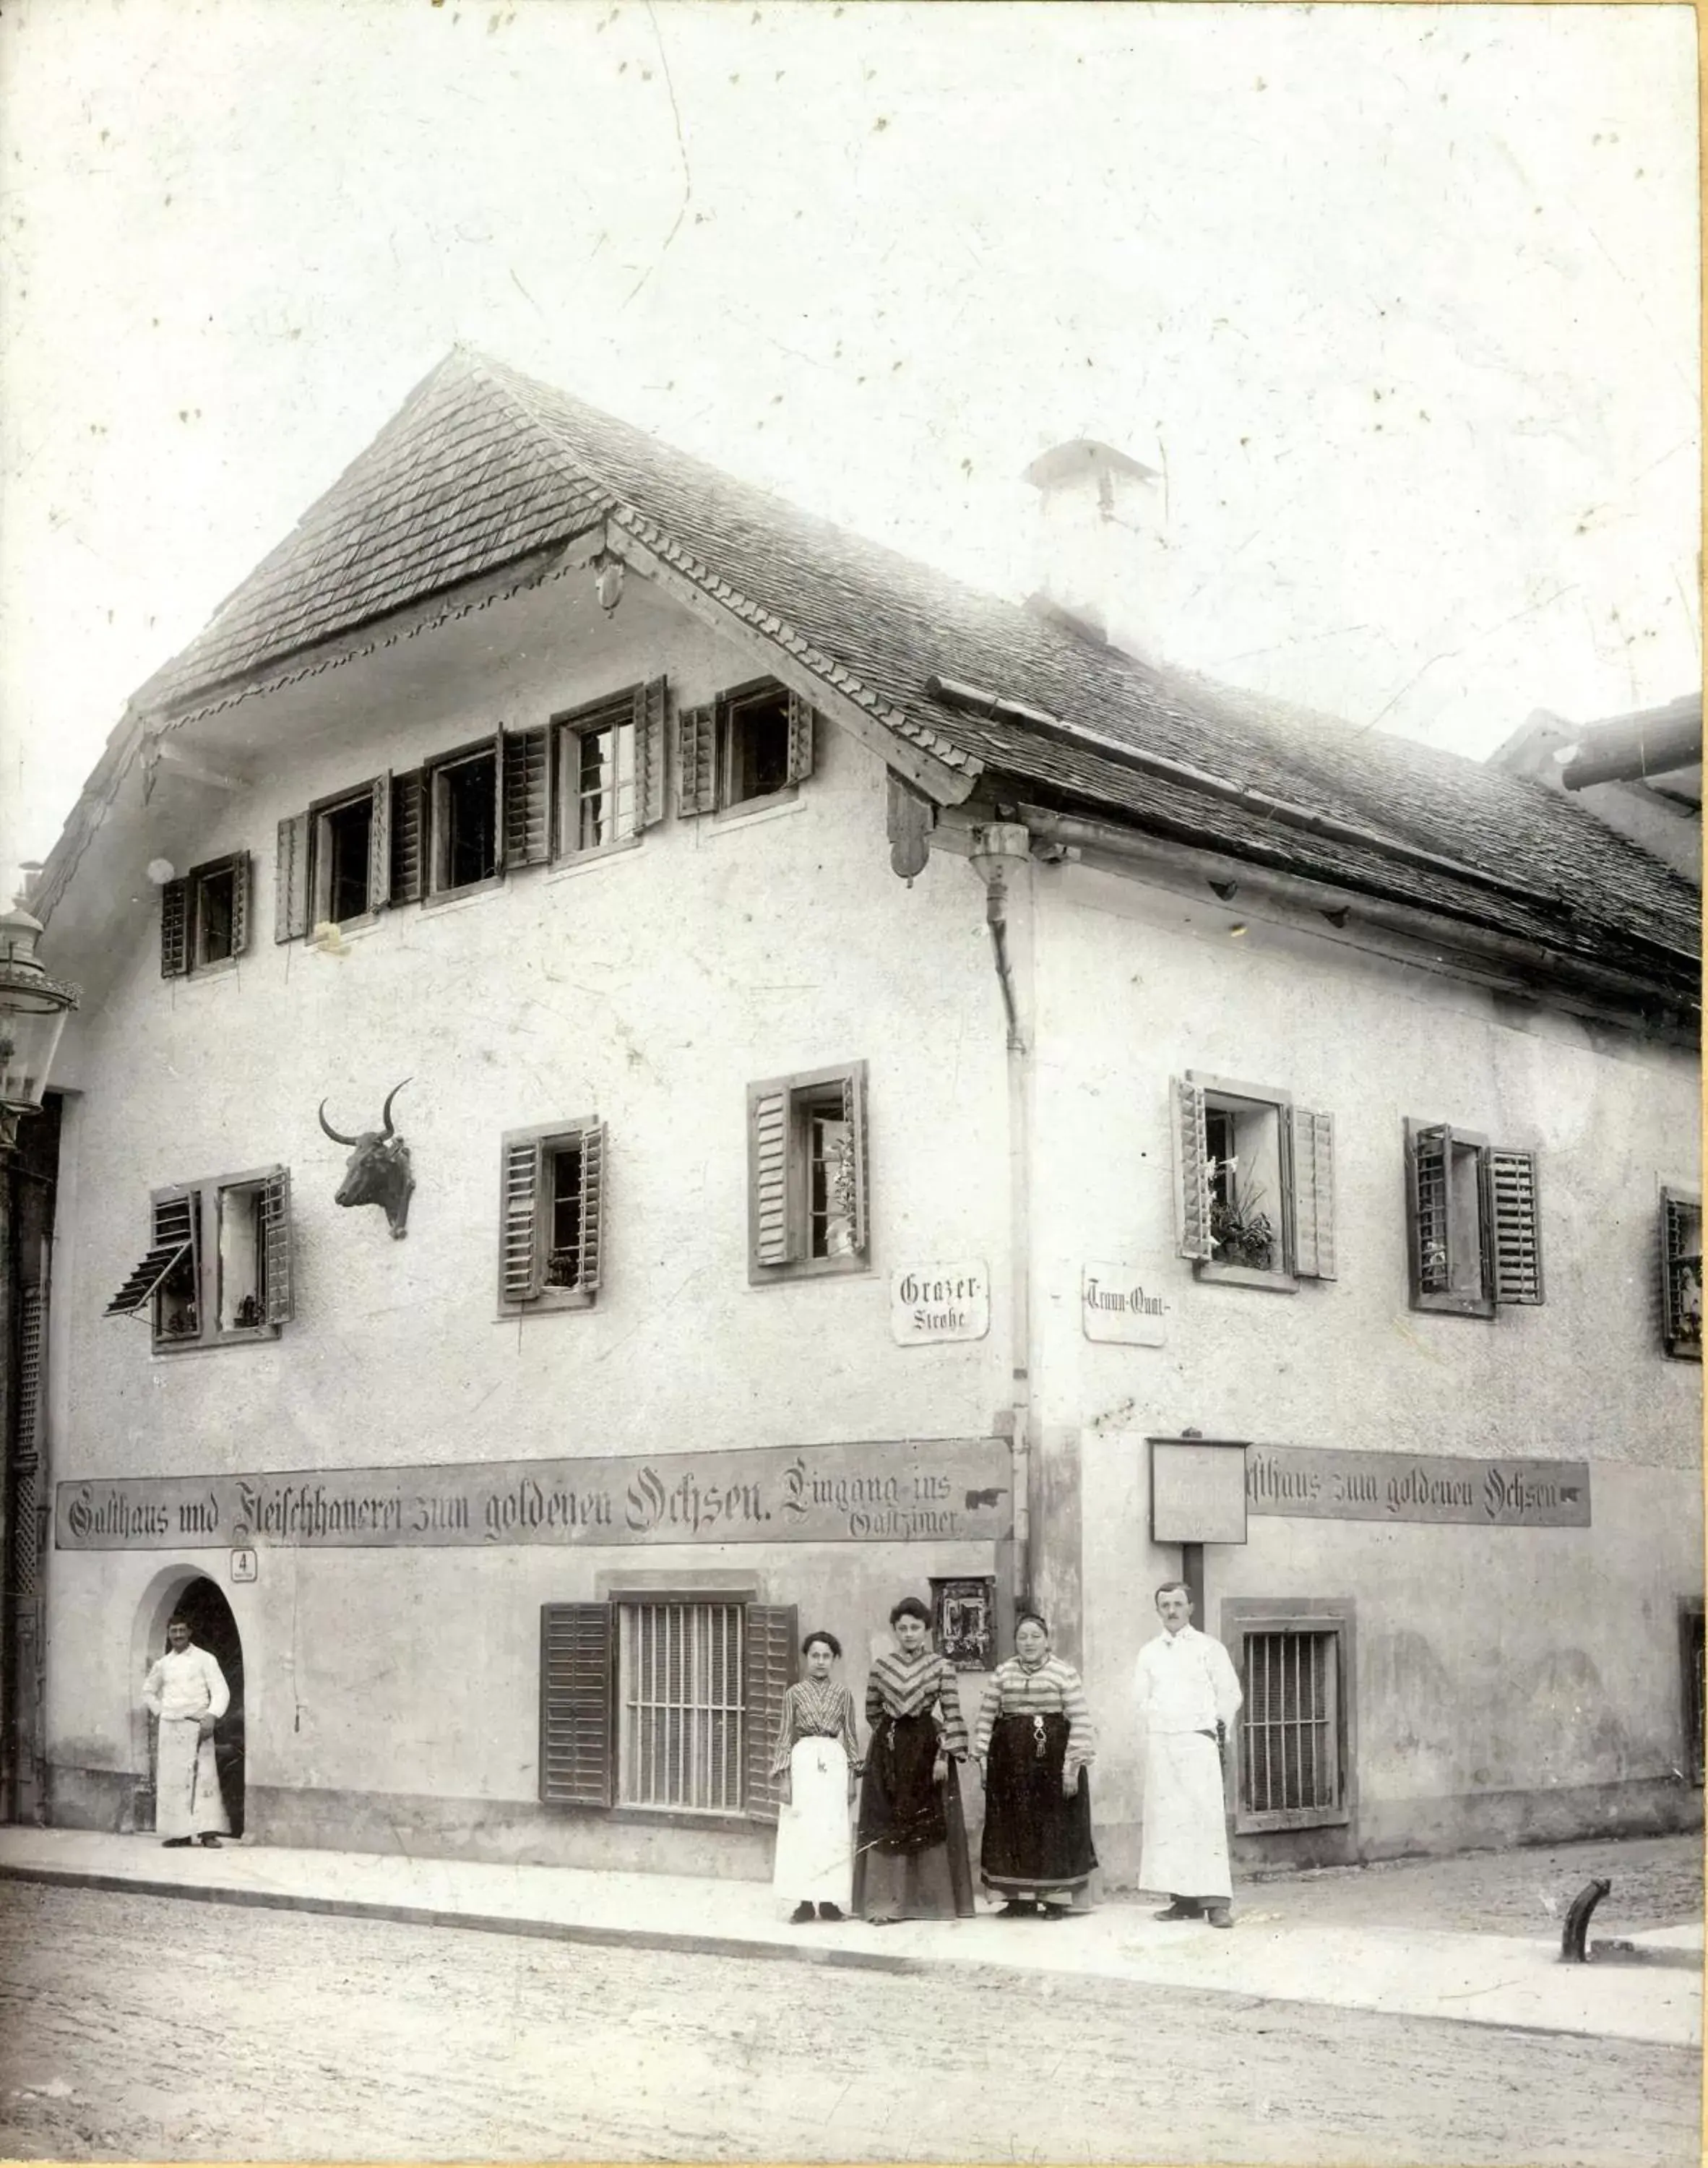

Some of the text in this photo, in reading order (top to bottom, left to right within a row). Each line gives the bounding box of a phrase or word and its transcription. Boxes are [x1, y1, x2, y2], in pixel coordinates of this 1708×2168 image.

[180, 1491, 219, 1533] und
[412, 1495, 470, 1531] zum
[485, 1478, 613, 1541] goldenen
[625, 1466, 771, 1533] Ochsen.
[780, 1456, 951, 1513] Eingang ins
[1332, 1472, 1378, 1503] zum
[1386, 1468, 1472, 1513] goldenen
[1483, 1468, 1556, 1518] Ochsen
[239, 1552, 246, 1572] 4
